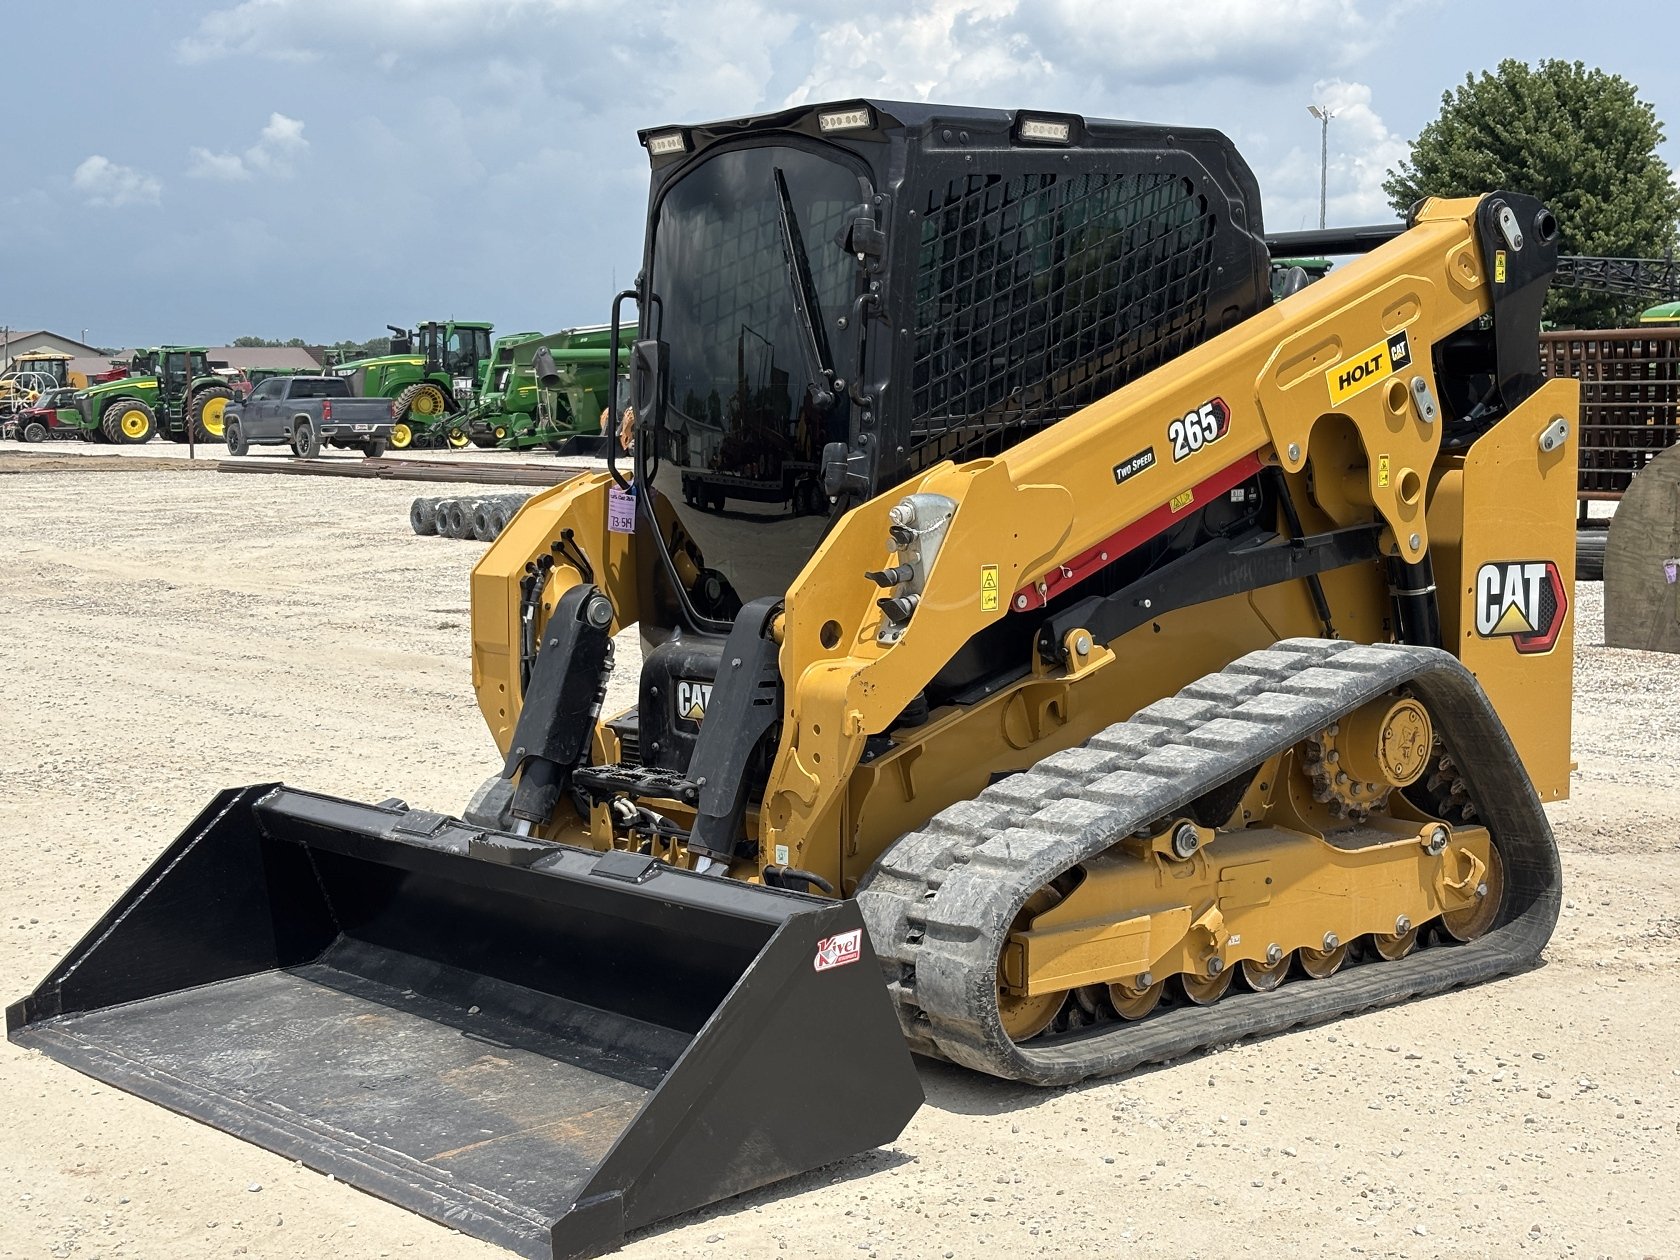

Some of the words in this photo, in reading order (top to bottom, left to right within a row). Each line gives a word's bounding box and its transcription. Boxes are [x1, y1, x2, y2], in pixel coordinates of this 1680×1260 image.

[1339, 353, 1383, 391] HOLT
[1391, 341, 1406, 361] CAT
[1169, 403, 1218, 460] 265
[1477, 563, 1546, 635] CAT
